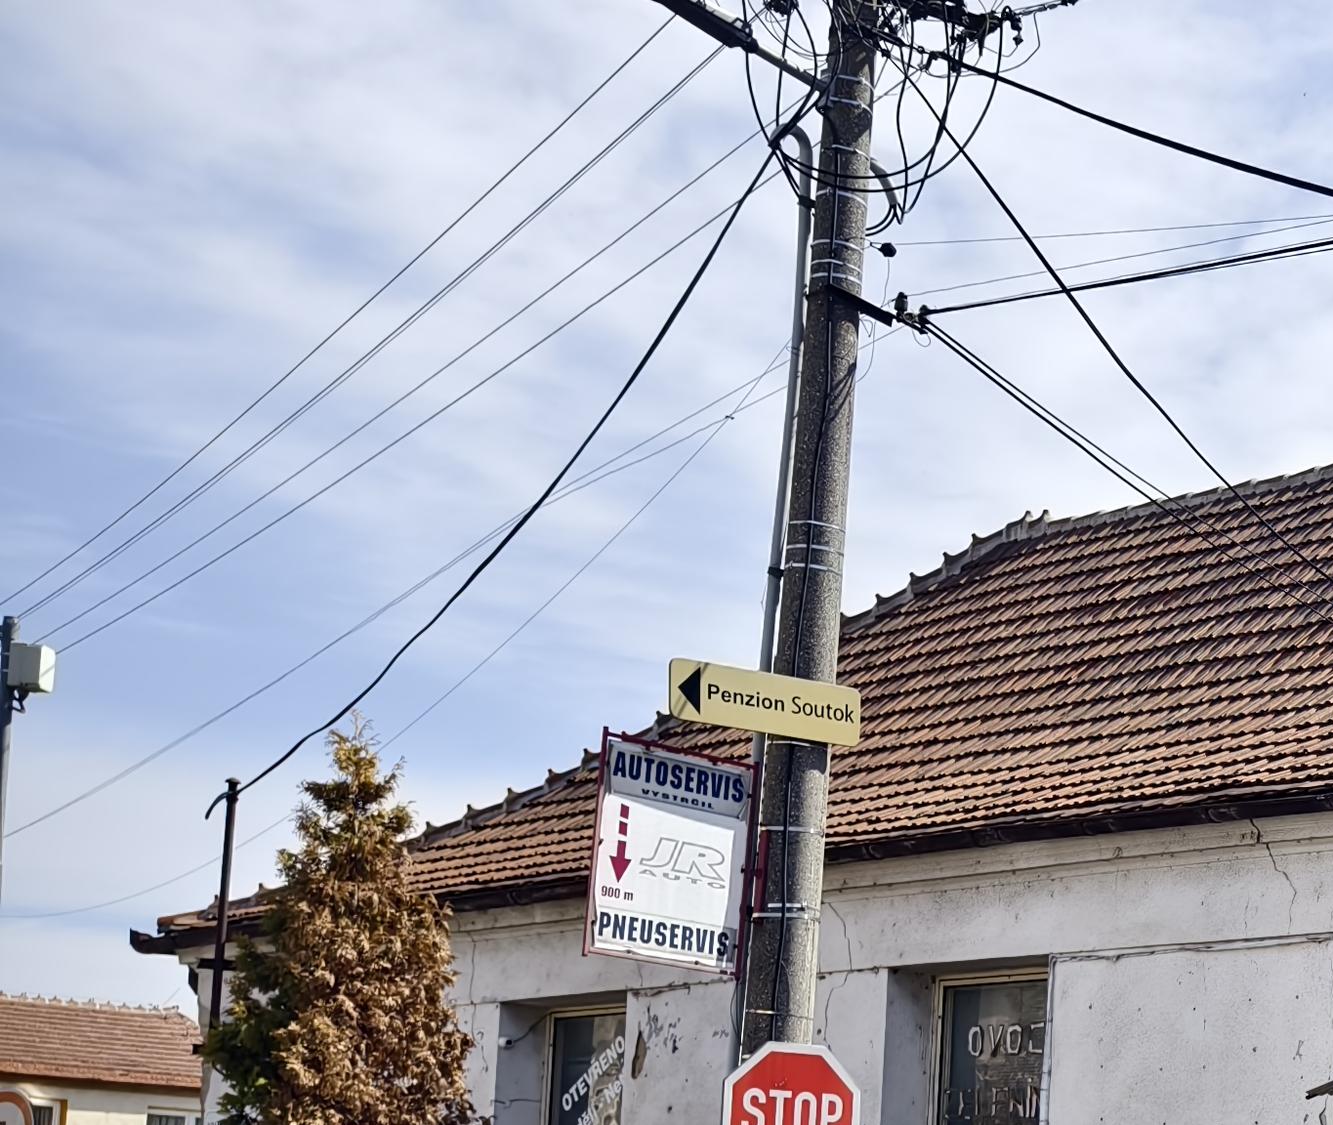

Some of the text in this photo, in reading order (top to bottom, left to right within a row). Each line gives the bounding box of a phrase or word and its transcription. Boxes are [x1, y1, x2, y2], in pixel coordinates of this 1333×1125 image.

[707, 683, 854, 724] Penzion Soutok
[612, 751, 744, 803] AUTOSERVIS
[639, 837, 725, 882] JR
[601, 886, 634, 901] 900 m
[598, 911, 729, 957] PNEUSERVIS
[968, 1022, 1045, 1057] OVOC
[562, 1036, 625, 1112] OTEVŘENO
